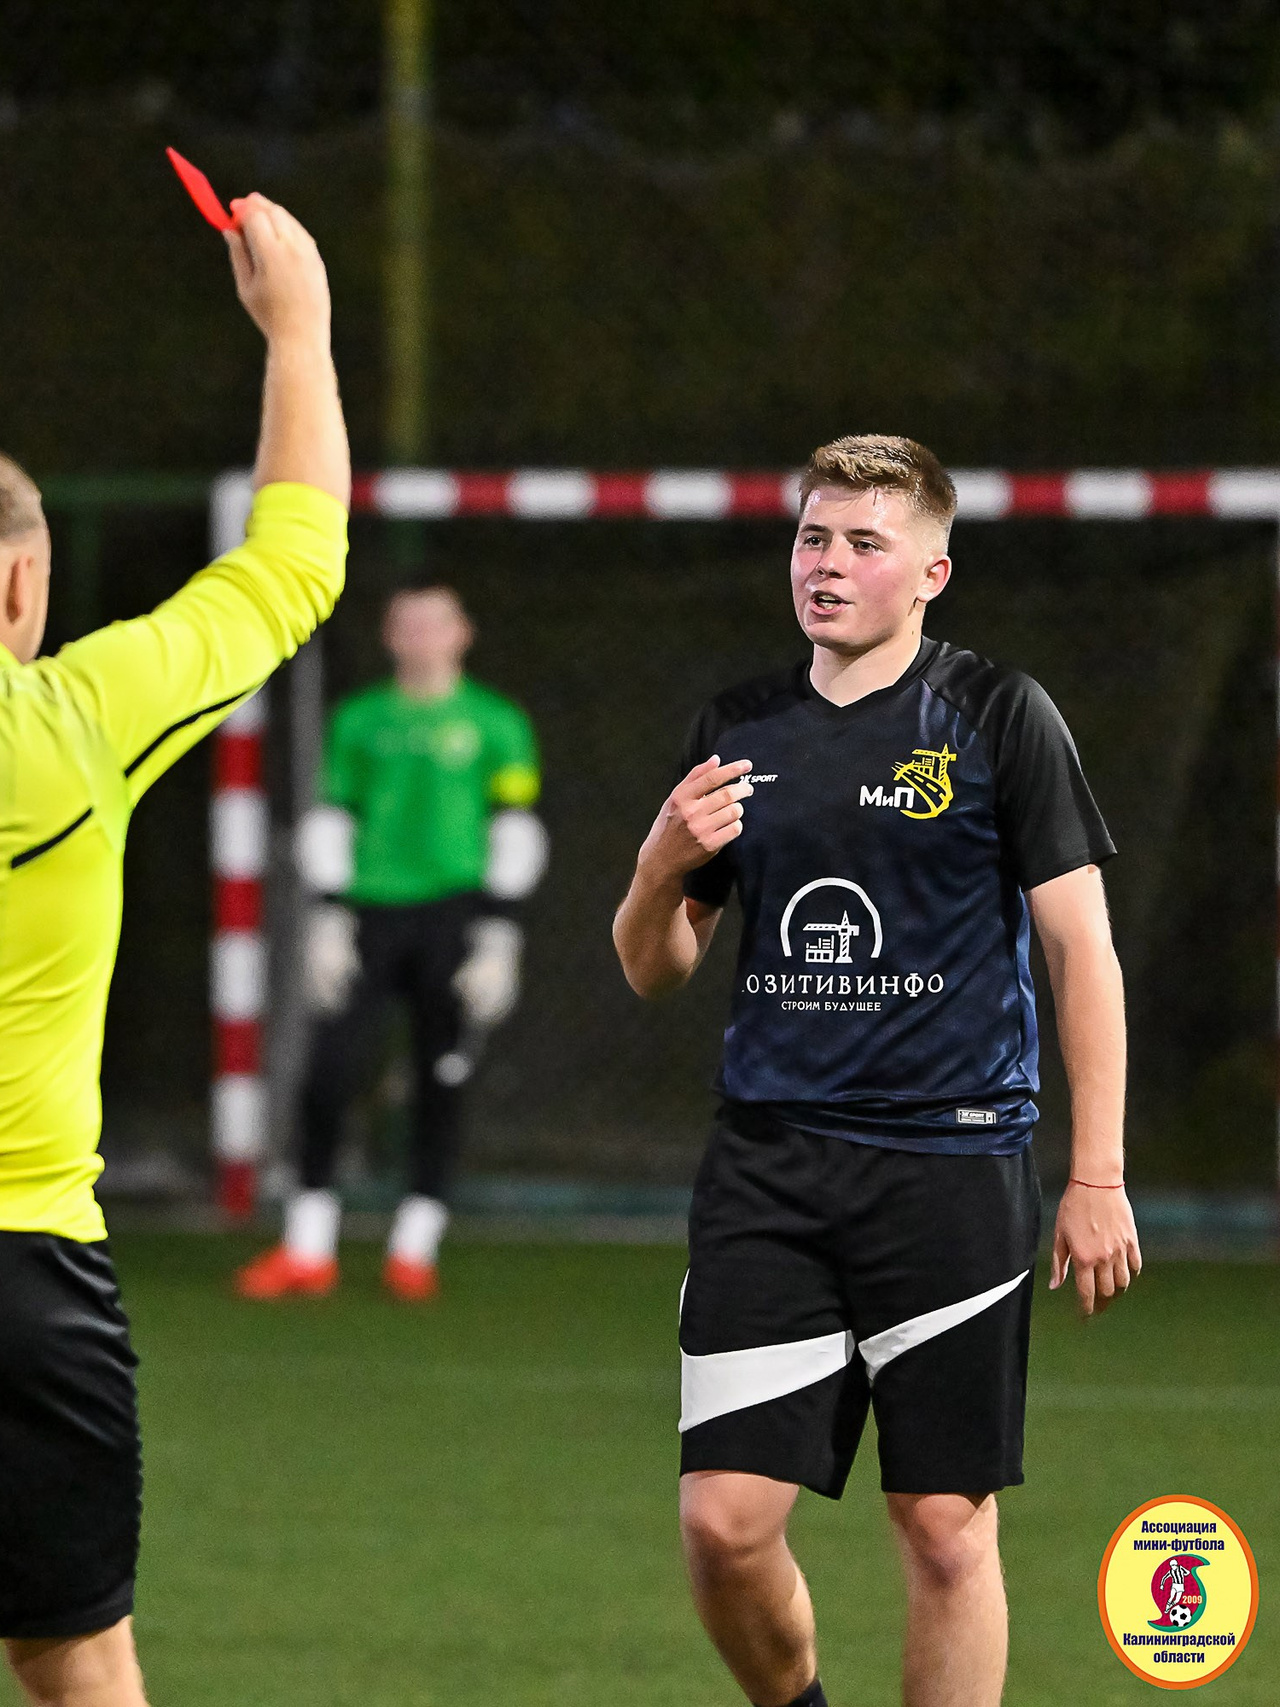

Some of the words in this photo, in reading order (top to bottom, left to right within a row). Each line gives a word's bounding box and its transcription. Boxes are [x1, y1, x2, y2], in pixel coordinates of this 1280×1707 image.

[751, 774, 779, 784] SPORT
[859, 784, 915, 809] МиП
[741, 972, 945, 998] ОЗИТИВИНФО
[781, 1000, 821, 1011] СТРОИМ
